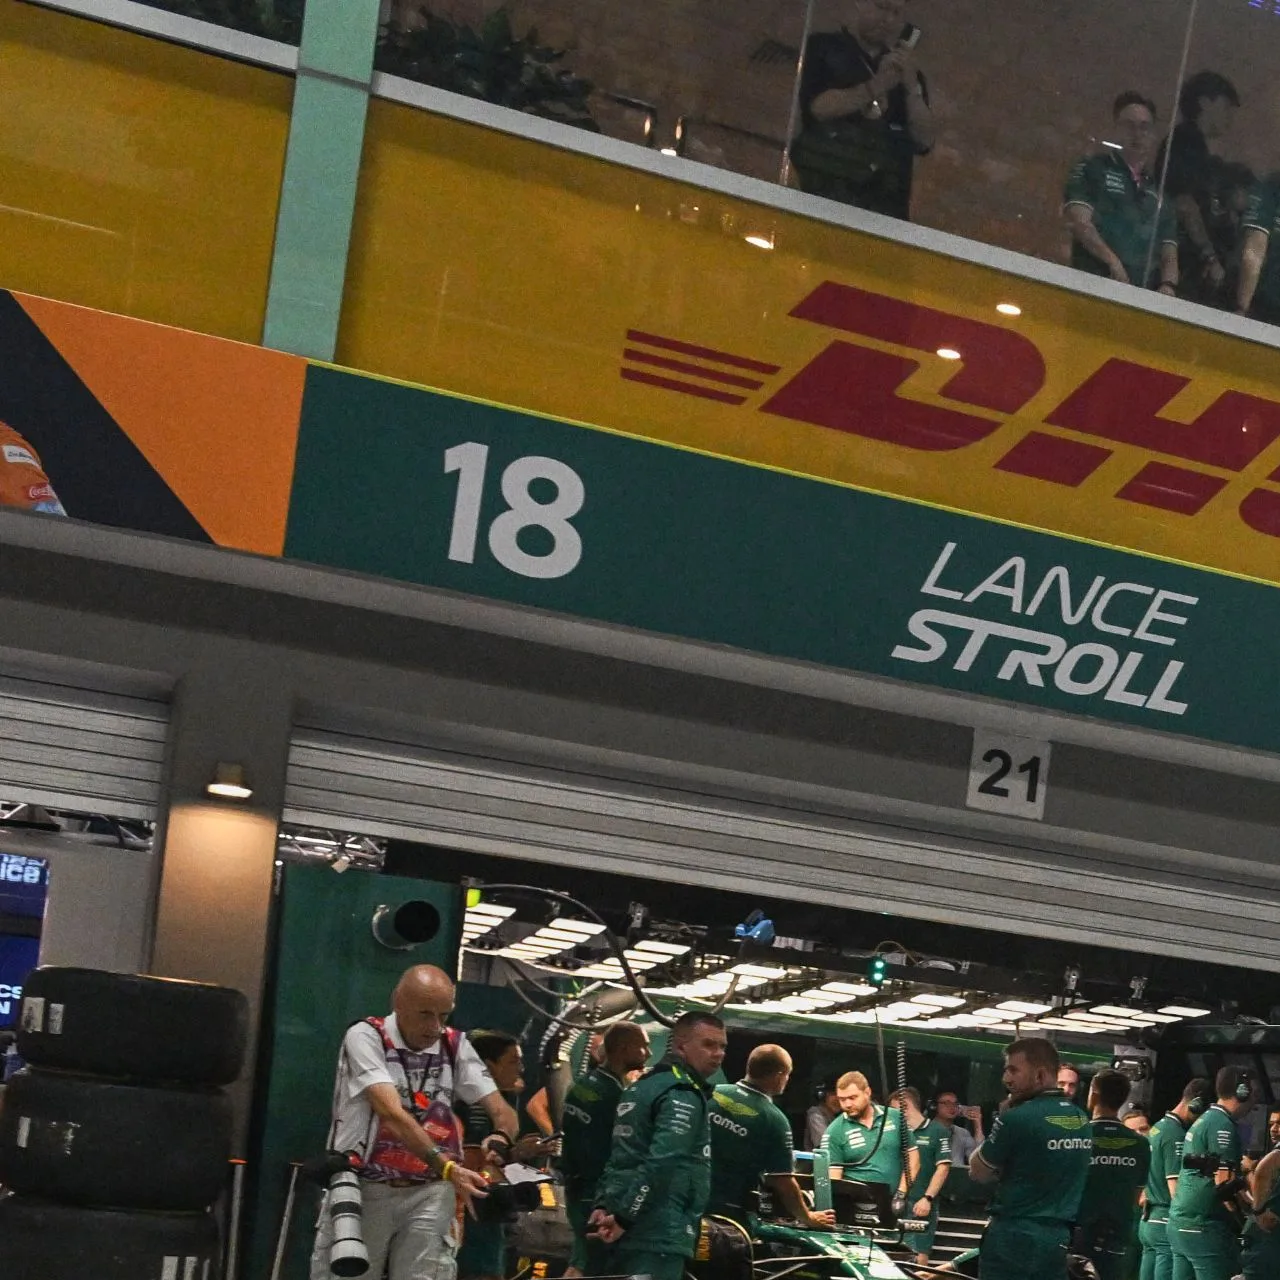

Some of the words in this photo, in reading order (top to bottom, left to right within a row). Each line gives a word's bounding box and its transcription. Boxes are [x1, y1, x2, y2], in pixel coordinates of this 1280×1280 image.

[444, 441, 585, 580] 18
[920, 541, 1199, 645] LANCE
[891, 608, 1189, 717] STROLL
[979, 747, 1042, 803] 21
[1047, 1138, 1092, 1151] aramc
